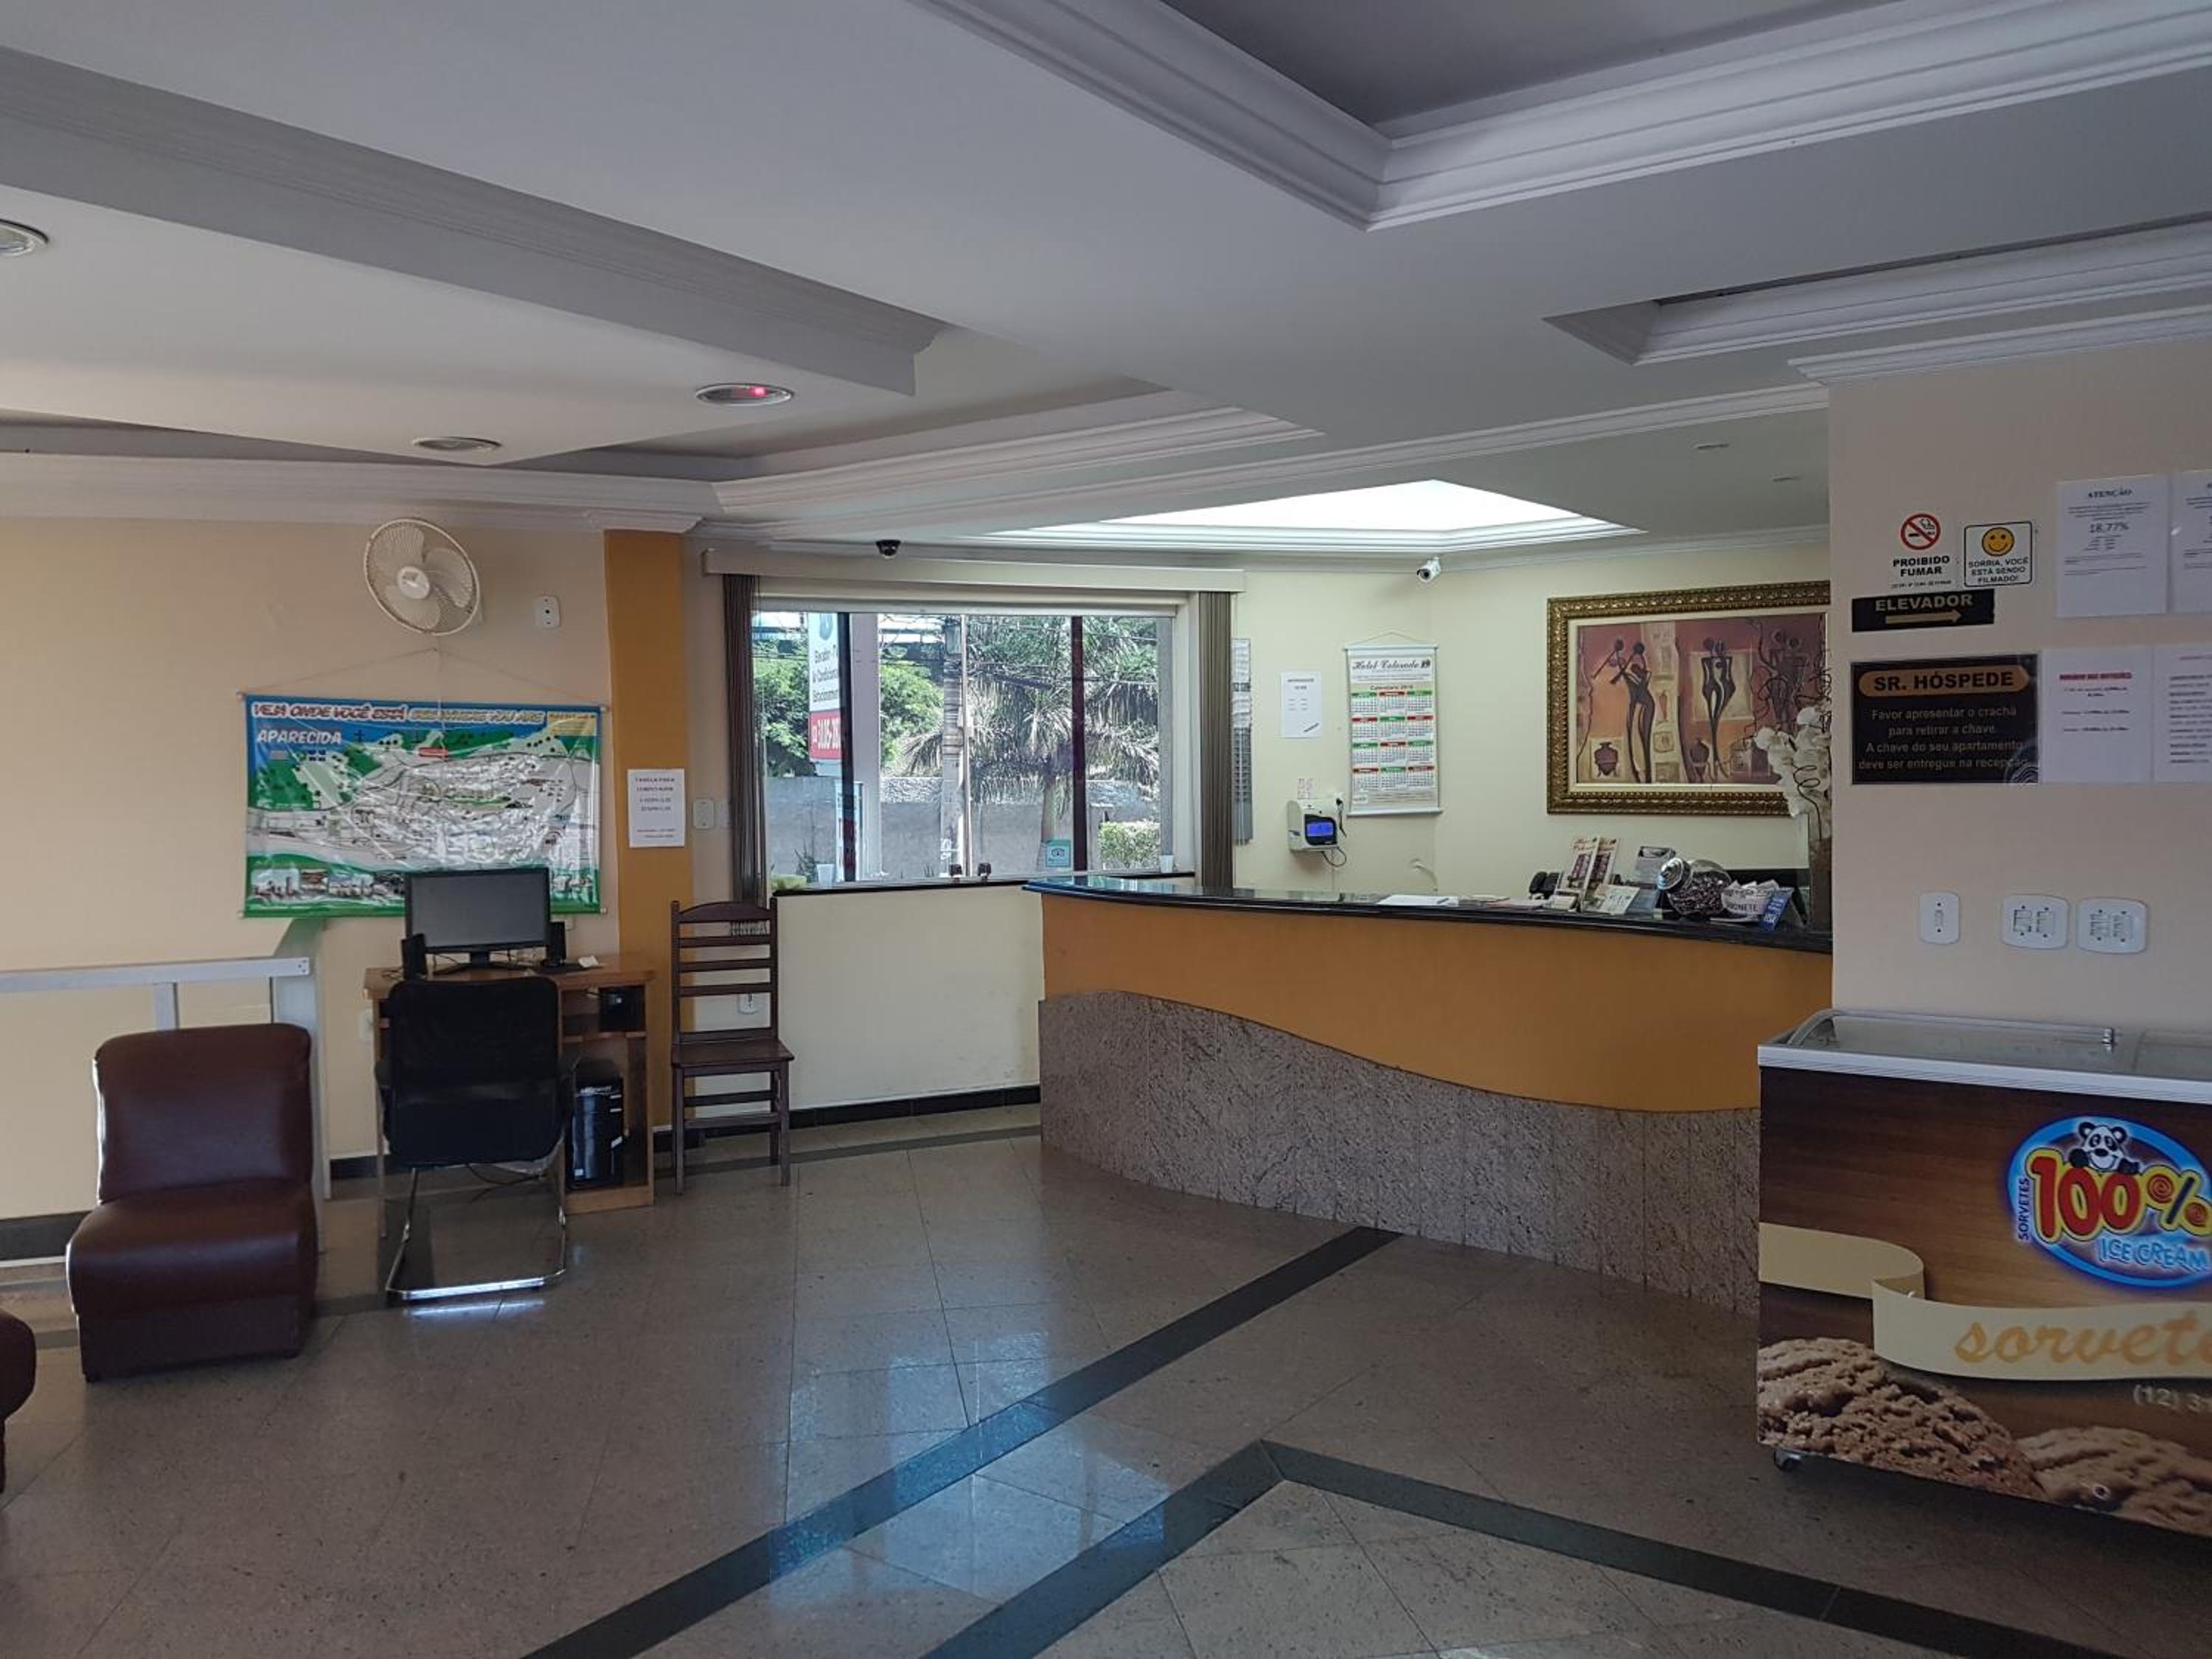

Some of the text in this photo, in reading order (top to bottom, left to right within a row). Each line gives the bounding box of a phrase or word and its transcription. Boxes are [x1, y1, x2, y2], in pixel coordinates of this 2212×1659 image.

[1893, 555, 1950, 567] PROIBIDO
[1968, 556, 2028, 568] SORRIA, VOCÊ
[1900, 566, 1942, 577] FUMAR
[1995, 566, 2026, 574] SENDO
[1875, 594, 1973, 611] ELEVADOR
[1874, 671, 2014, 691] SR. HÓSPEDE
[291, 704, 331, 717] ONDE
[333, 703, 370, 719] VOCÊ
[1872, 706, 2017, 722] Favor apresentar o crachá
[257, 729, 342, 745] APARECIDA
[1888, 727, 1913, 738] para
[1916, 726, 1949, 735] retirar
[1962, 723, 1995, 734] chave
[1865, 743, 1875, 753] A
[1877, 741, 1909, 752] chave
[1912, 741, 1927, 751] do
[1930, 742, 1950, 751] seu
[1859, 759, 1885, 770] deve
[1887, 759, 1904, 769] ser
[1907, 758, 1956, 771] entregue
[1959, 759, 1972, 768] na
[2030, 1154, 2211, 1239] 100%
[2018, 1178, 2030, 1241] SORVETES
[2100, 1239, 2209, 1272] ICE CREAM
